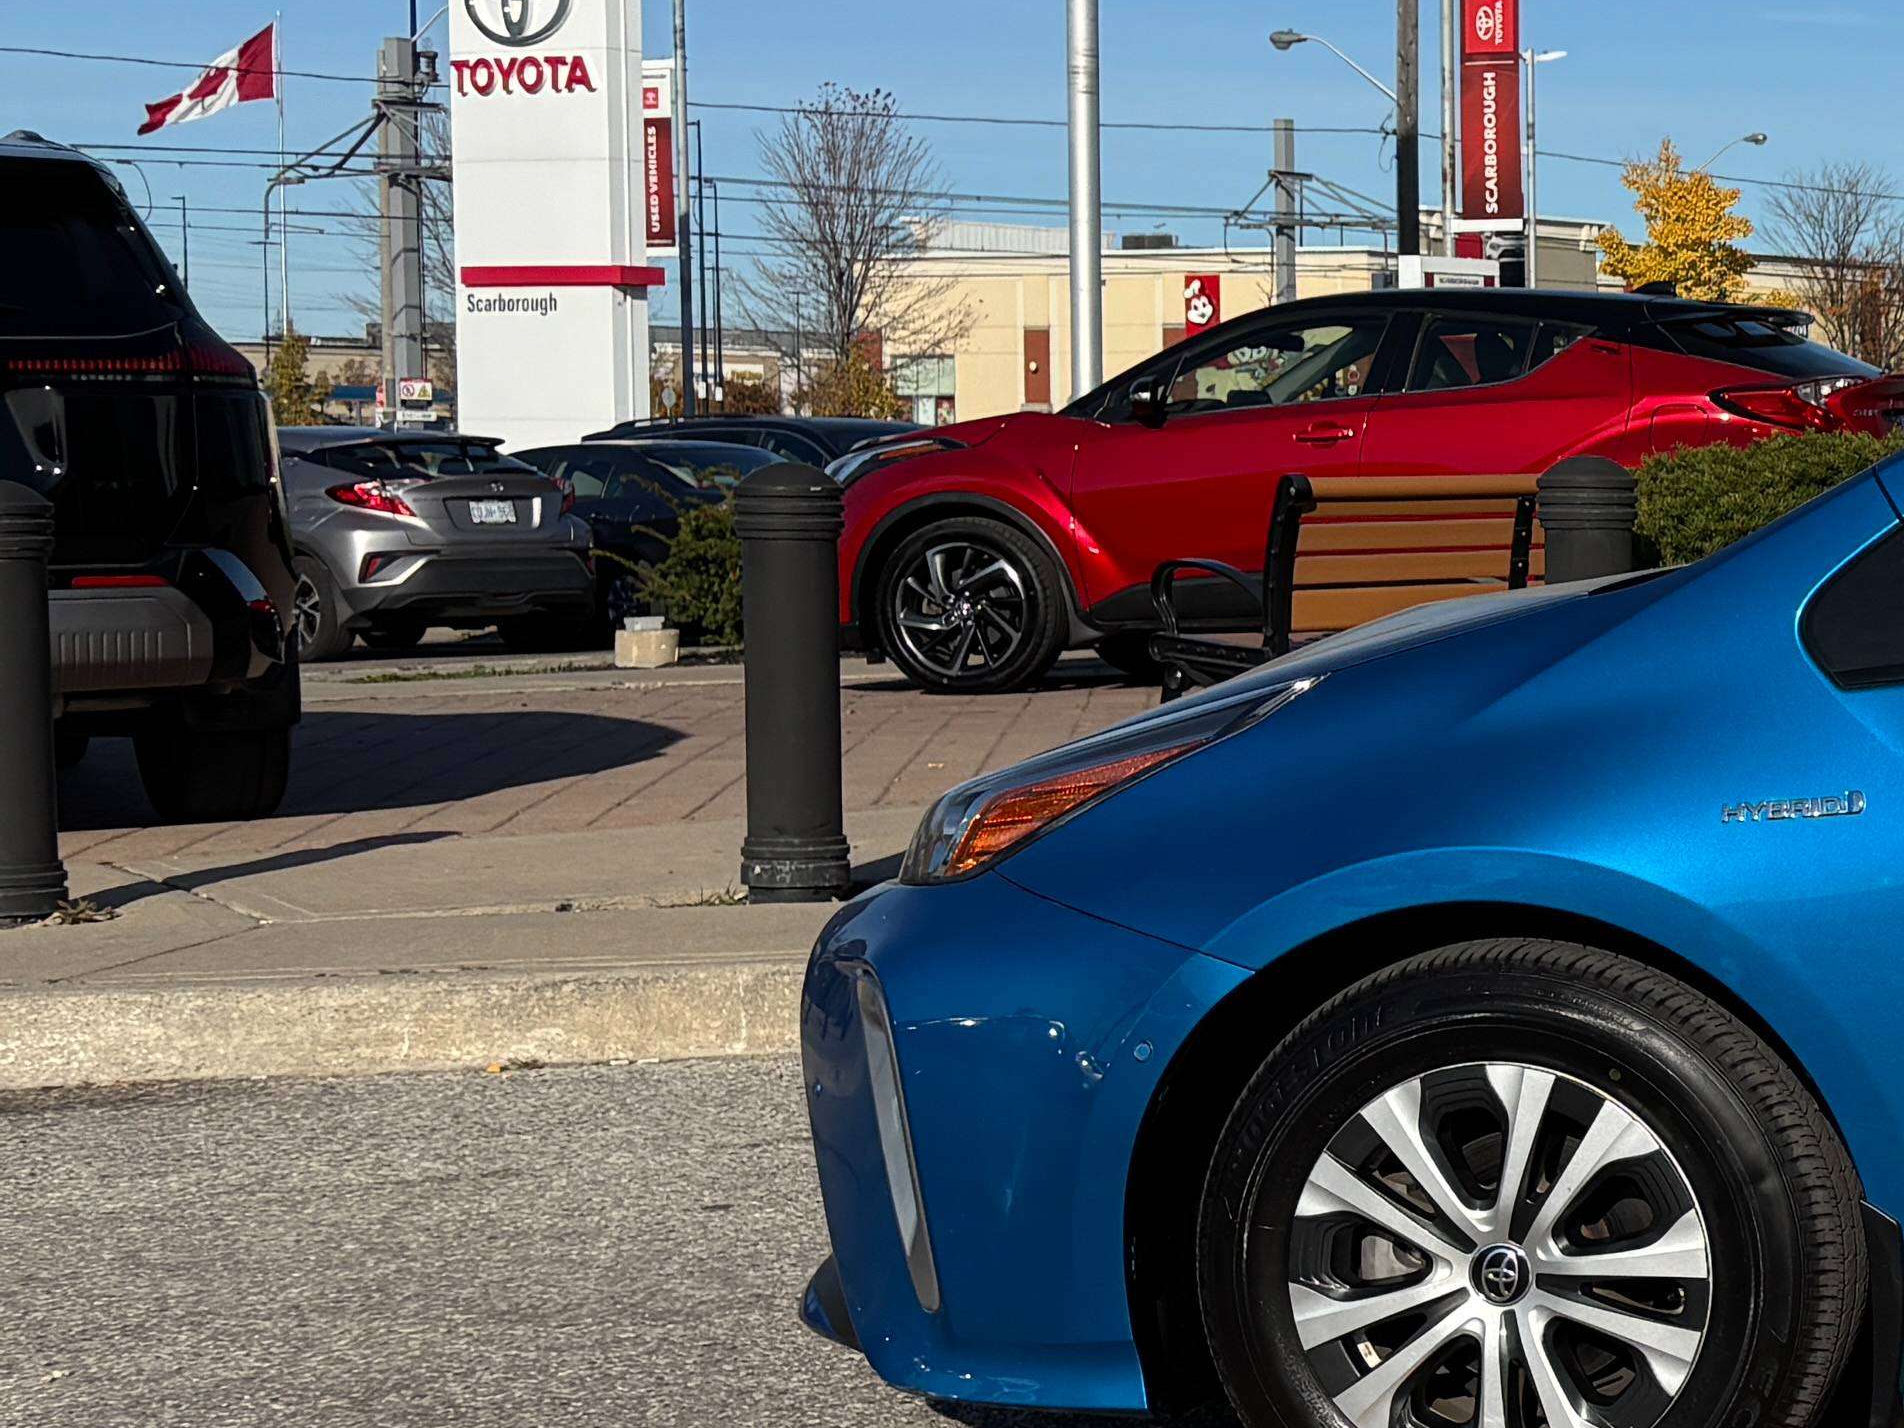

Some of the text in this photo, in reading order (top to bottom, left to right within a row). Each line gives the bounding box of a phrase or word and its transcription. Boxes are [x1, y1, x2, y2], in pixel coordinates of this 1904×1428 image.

[1494, 0, 1504, 45] TOYOTA
[450, 55, 598, 97] TOYOTA
[1483, 71, 1499, 214] SCARBOROUGH
[647, 125, 661, 233] USED VEHICLES
[467, 292, 558, 316] Scarborough
[1721, 795, 1845, 822] HYBRID
